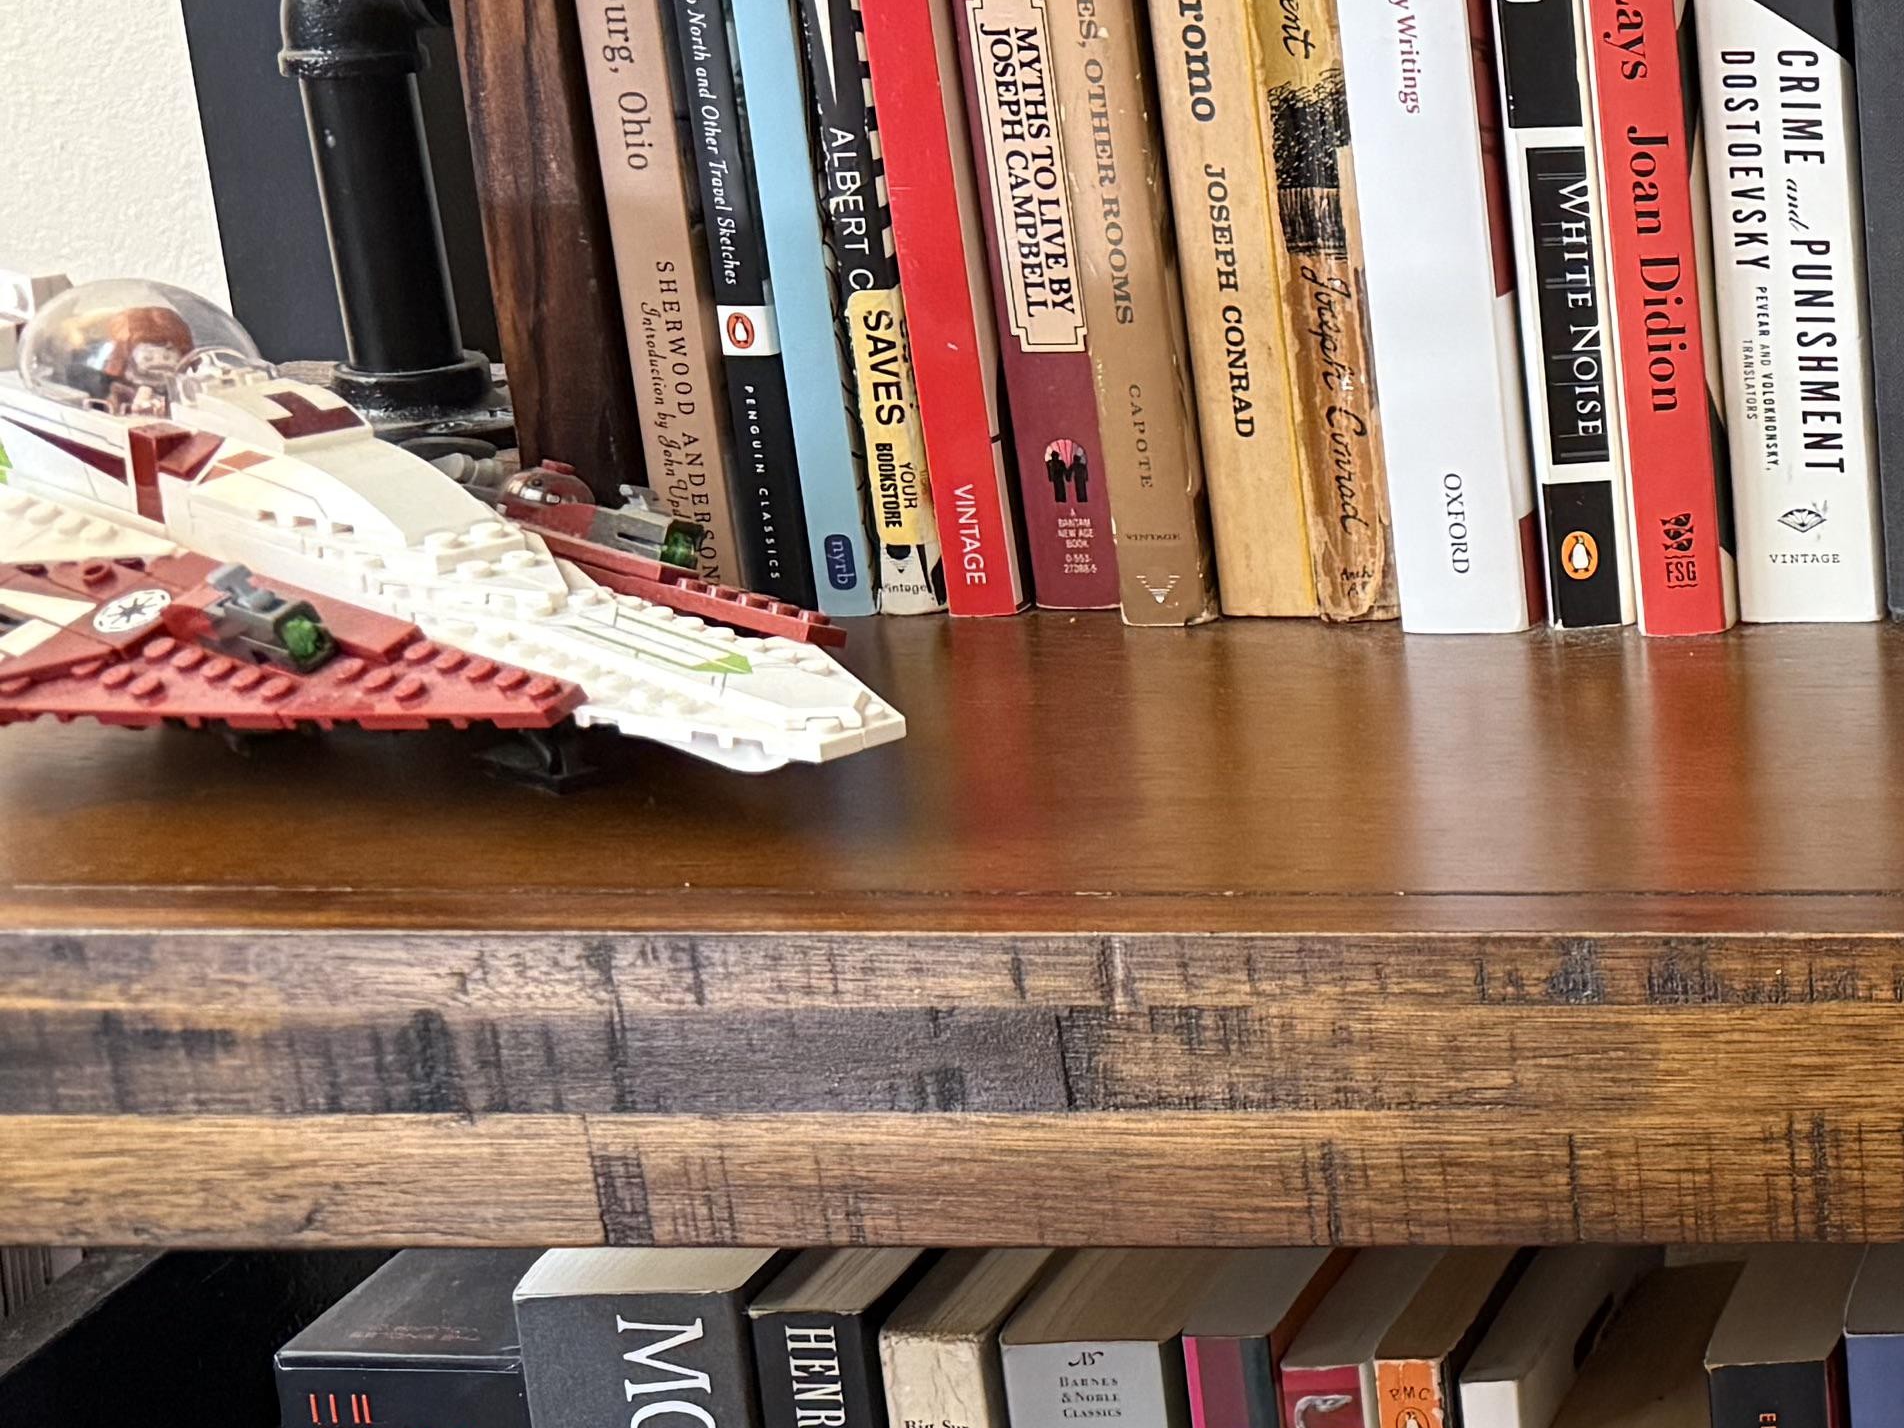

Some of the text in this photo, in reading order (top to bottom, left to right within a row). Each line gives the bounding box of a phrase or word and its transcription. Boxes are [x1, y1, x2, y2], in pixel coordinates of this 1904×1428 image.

[1396, 11, 1421, 114] Writings
[1720, 51, 1770, 271] DOSTOEVSKY
[1203, 163, 1256, 439] JOSEPH CONRAD
[1625, 124, 1689, 414] Joan Didion
[1777, 51, 1845, 476] CRIME and PUNISHMENT
[862, 310, 904, 426] SAVES
[1755, 286, 1780, 472] PEVEAR AND VOLOKHONSKY,
[1442, 473, 1470, 574] OXFORD
[1769, 553, 1841, 564] VINTAGE
